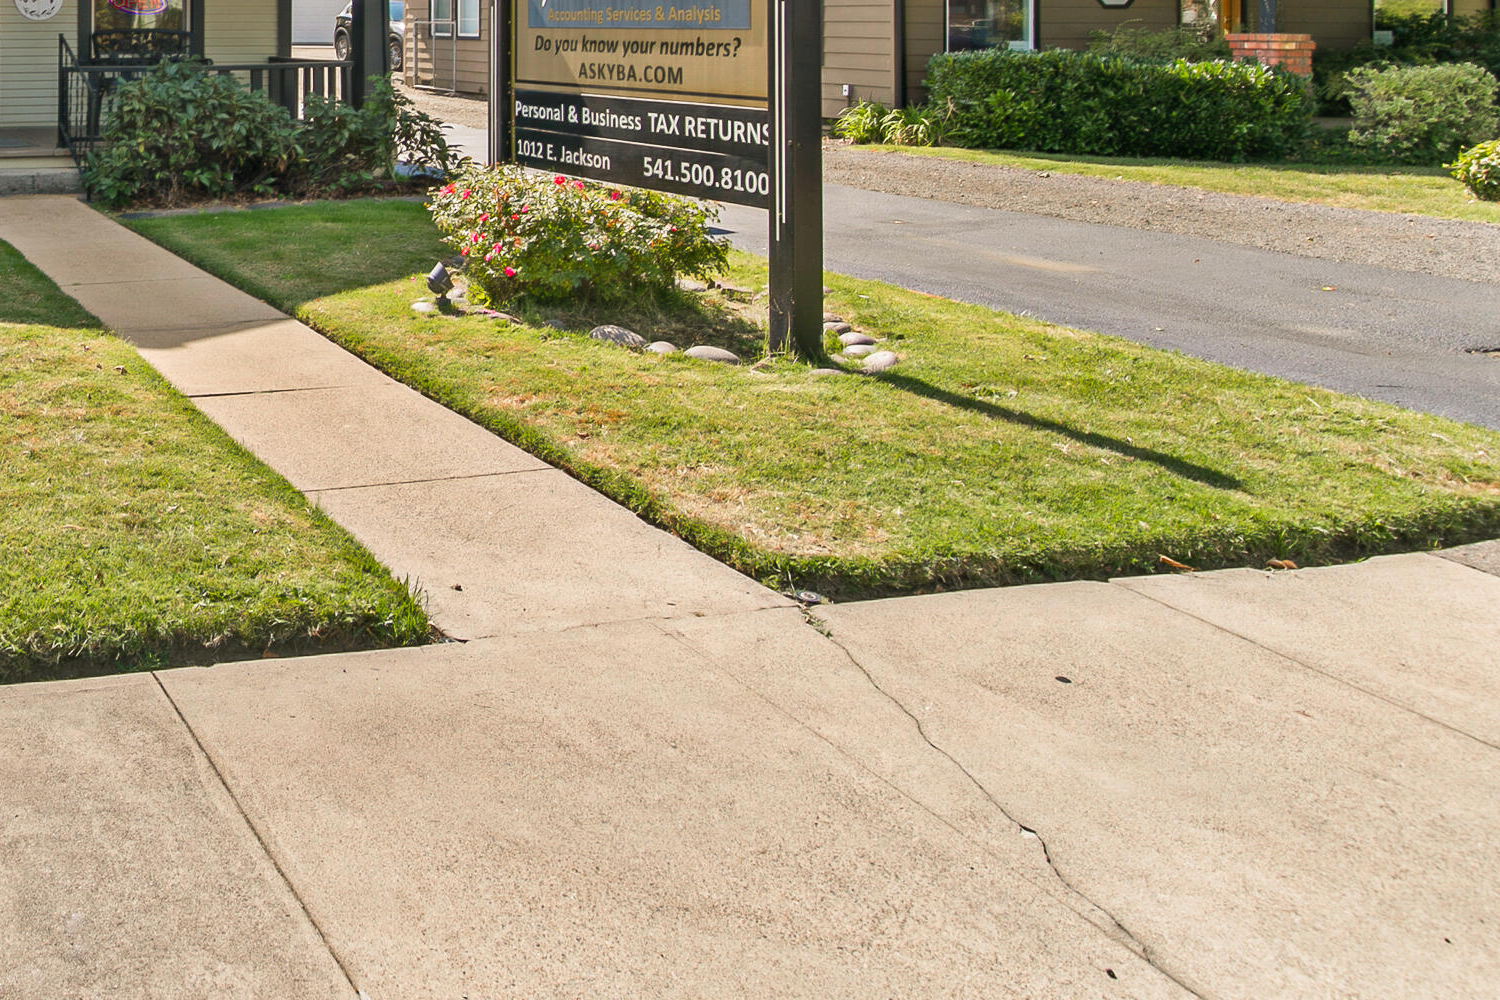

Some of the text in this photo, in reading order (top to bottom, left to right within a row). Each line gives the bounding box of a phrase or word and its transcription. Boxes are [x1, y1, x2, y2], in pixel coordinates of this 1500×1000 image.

[548, 5, 721, 25] Accounting Services & Analysis
[535, 34, 742, 58] Do you know your numbers?
[578, 62, 683, 85] ASKYBA.COM
[515, 100, 769, 146] Personal & Business TAX RETURNS
[517, 139, 611, 171] 1012 E. Jackson
[643, 156, 769, 195] 541.500.8100
